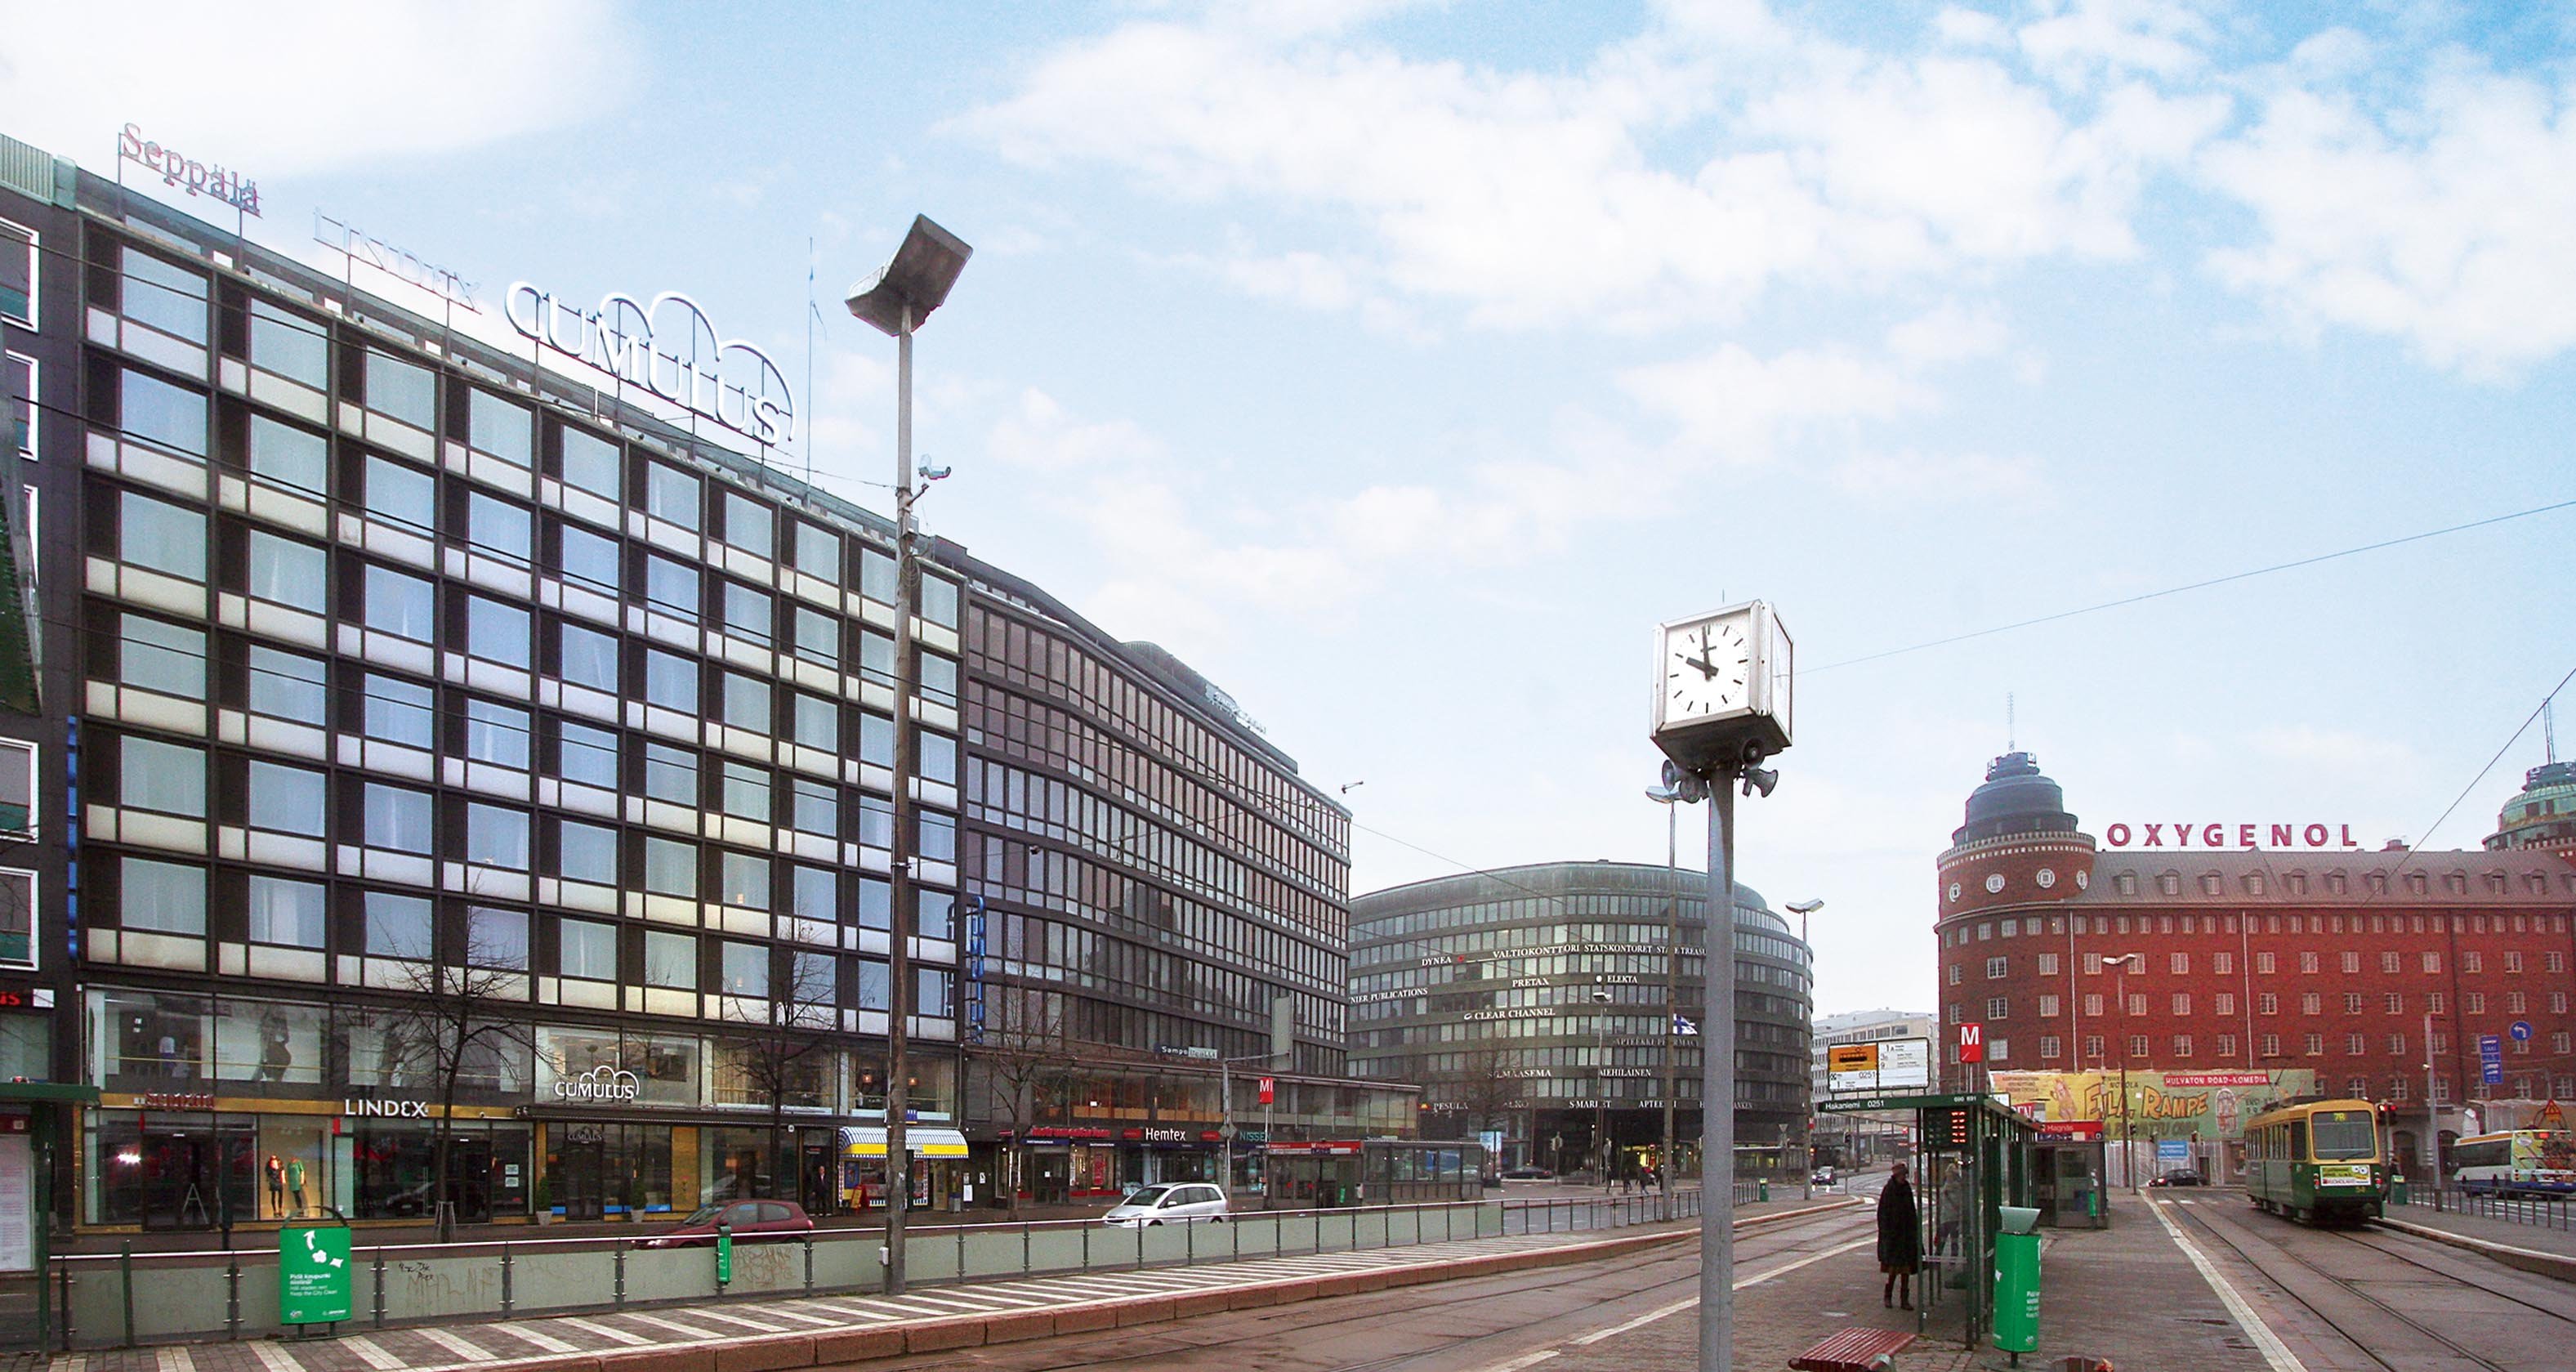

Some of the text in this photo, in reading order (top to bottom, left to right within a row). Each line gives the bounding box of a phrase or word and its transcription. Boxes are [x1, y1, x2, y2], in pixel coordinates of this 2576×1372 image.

[123, 122, 261, 216] Seppälä
[314, 206, 481, 312] LINDEX
[504, 280, 780, 448] CUMULUS
[2107, 823, 2357, 847] OXYGENOL
[1493, 944, 1579, 959] VALTIOKONTTORI
[1584, 944, 1652, 953] STATSKONTORET
[1657, 946, 1707, 956] STAE TREASU
[1422, 956, 1452, 967] DYNEA
[1512, 978, 1550, 988] PRETAX
[1607, 975, 1638, 984] ELEKTA
[1349, 987, 1429, 1003] NIER PUBLICATIONS
[1475, 1008, 1556, 1021] CLEAR CHANNEL
[1961, 1026, 1980, 1046] M
[1161, 1046, 1189, 1056] Sampo
[2165, 1076, 2205, 1084] HULVATON
[554, 1080, 636, 1099] CUMULUS
[345, 1098, 428, 1117] LINDEX
[1569, 1100, 1612, 1109] S-MART
[1638, 1100, 1676, 1109] APTEEI
[2141, 1085, 2208, 1119] RAMPE
[1145, 1128, 1185, 1142] Hemtex
